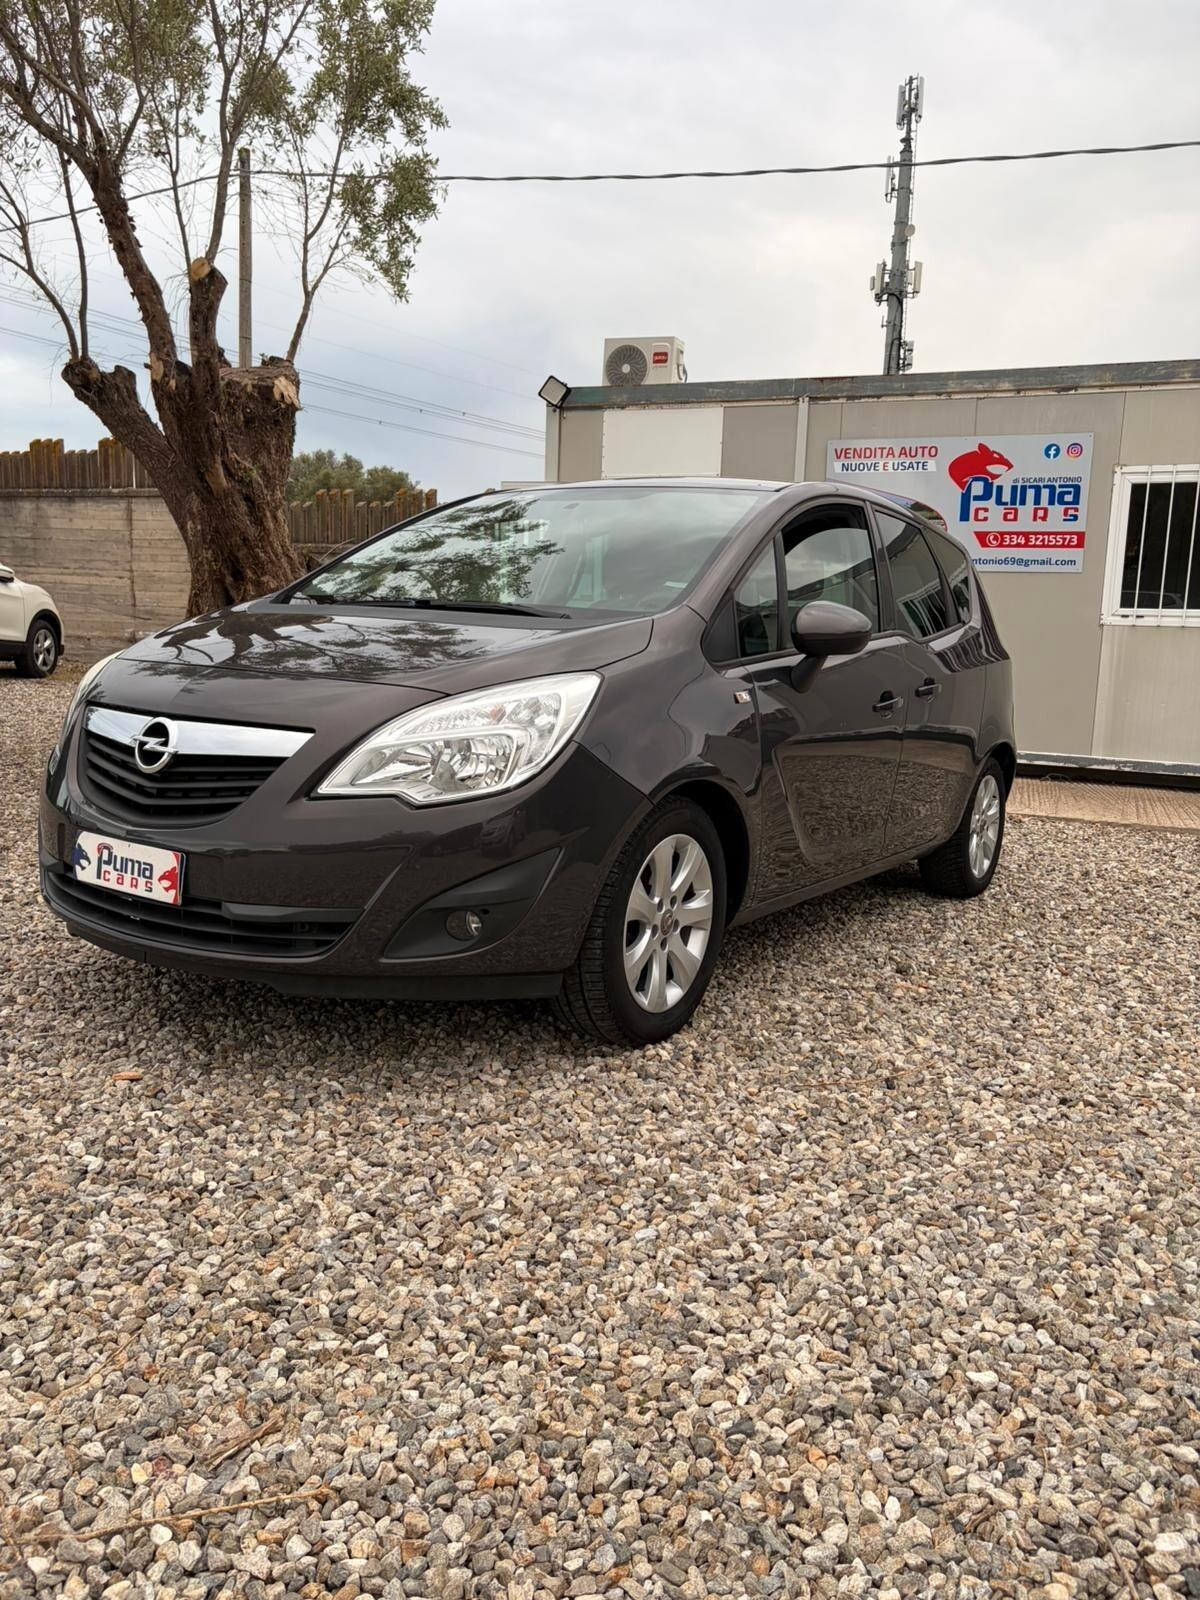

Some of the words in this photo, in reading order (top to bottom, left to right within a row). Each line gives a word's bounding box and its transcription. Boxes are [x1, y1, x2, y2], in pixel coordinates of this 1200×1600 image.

[834, 446, 895, 460] VENDITA
[897, 445, 939, 459] AUTO
[841, 461, 880, 472] NUOVE
[882, 461, 889, 471] E
[891, 461, 928, 471] USATE
[1046, 476, 1082, 484] ANTONIO
[1002, 535, 1025, 545] 334
[1028, 534, 1078, 545] 3215573
